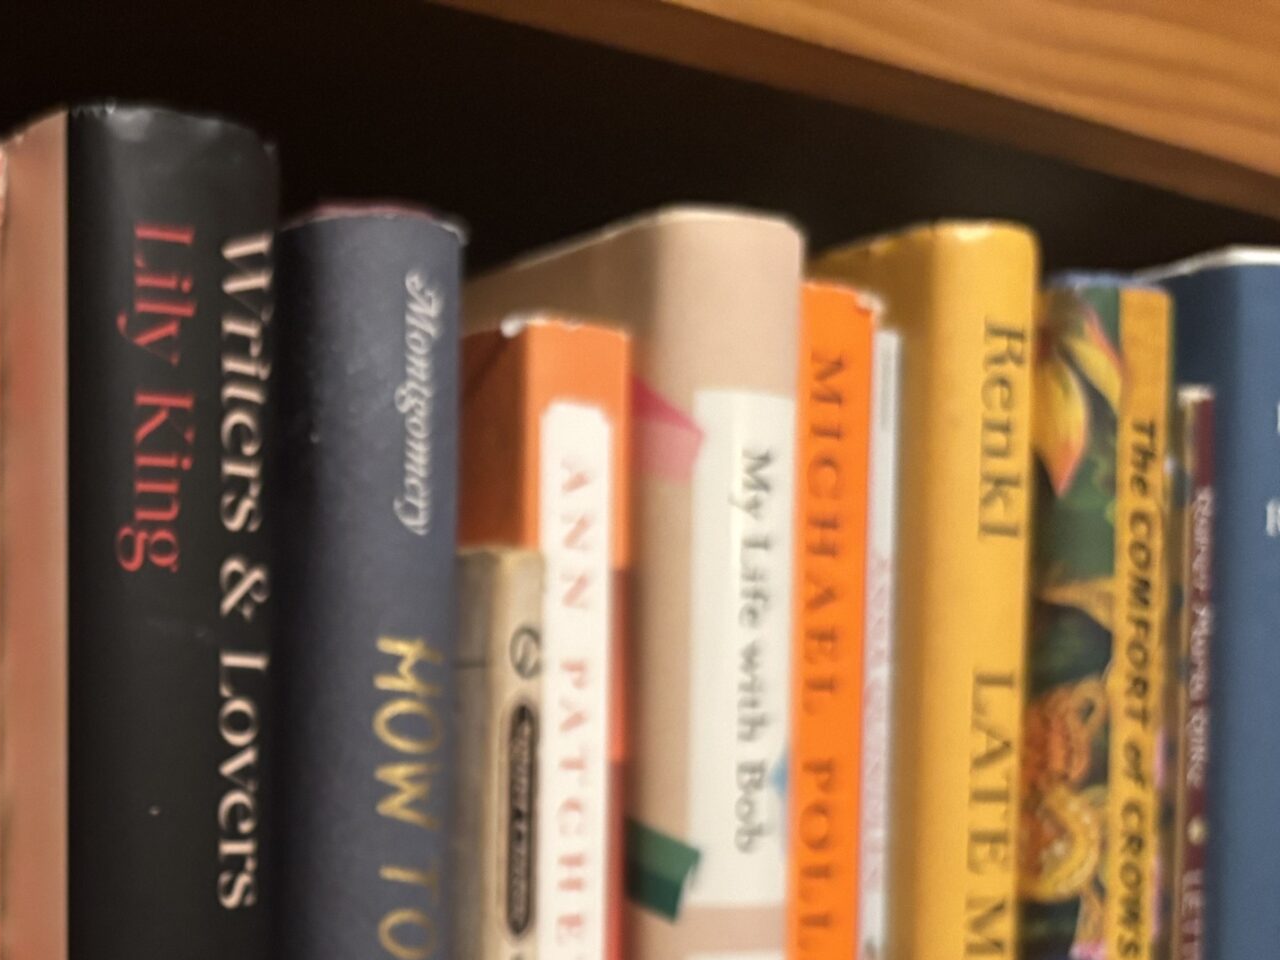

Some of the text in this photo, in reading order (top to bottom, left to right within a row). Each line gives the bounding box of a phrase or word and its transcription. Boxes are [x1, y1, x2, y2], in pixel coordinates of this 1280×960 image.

[118, 221, 196, 574] Lily King
[394, 268, 444, 537] Montgomery
[977, 316, 1029, 542] Renkl
[218, 233, 275, 910] Writers & Lovers
[560, 459, 595, 609] ANN
[802, 350, 847, 717] MICHAEL
[1122, 506, 1155, 727] COMFORT
[372, 637, 446, 830] HOW
[727, 444, 775, 855] My Life with Bob
[964, 668, 1018, 878] LATE
[1114, 798, 1145, 960] CROWS
[377, 864, 440, 960] TO
